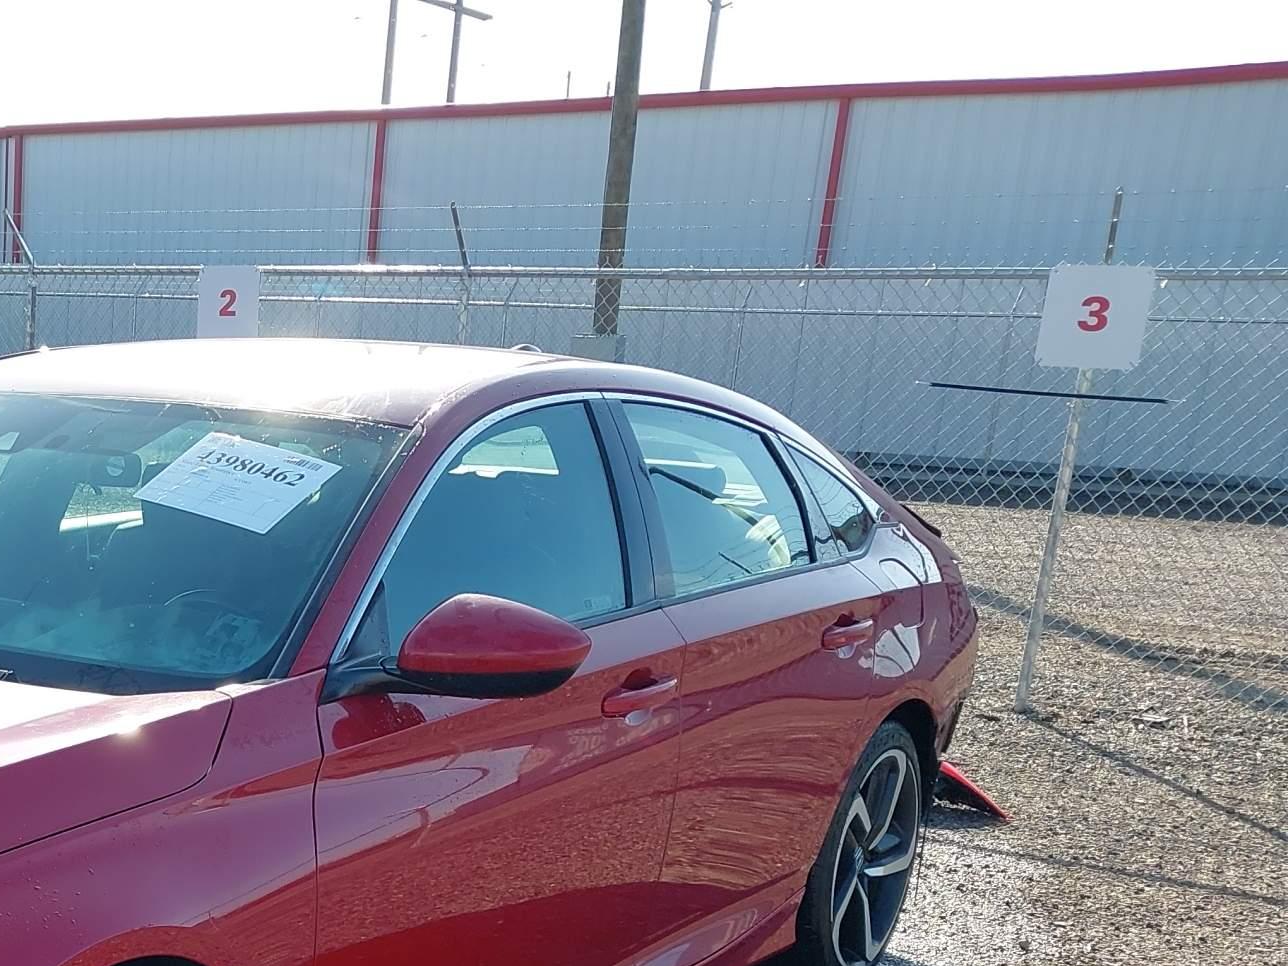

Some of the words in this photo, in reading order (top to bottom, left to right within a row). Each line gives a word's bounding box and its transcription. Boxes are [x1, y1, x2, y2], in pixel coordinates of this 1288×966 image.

[219, 289, 237, 317] 2
[1076, 295, 1111, 332] 3
[196, 449, 305, 487] 43980462
